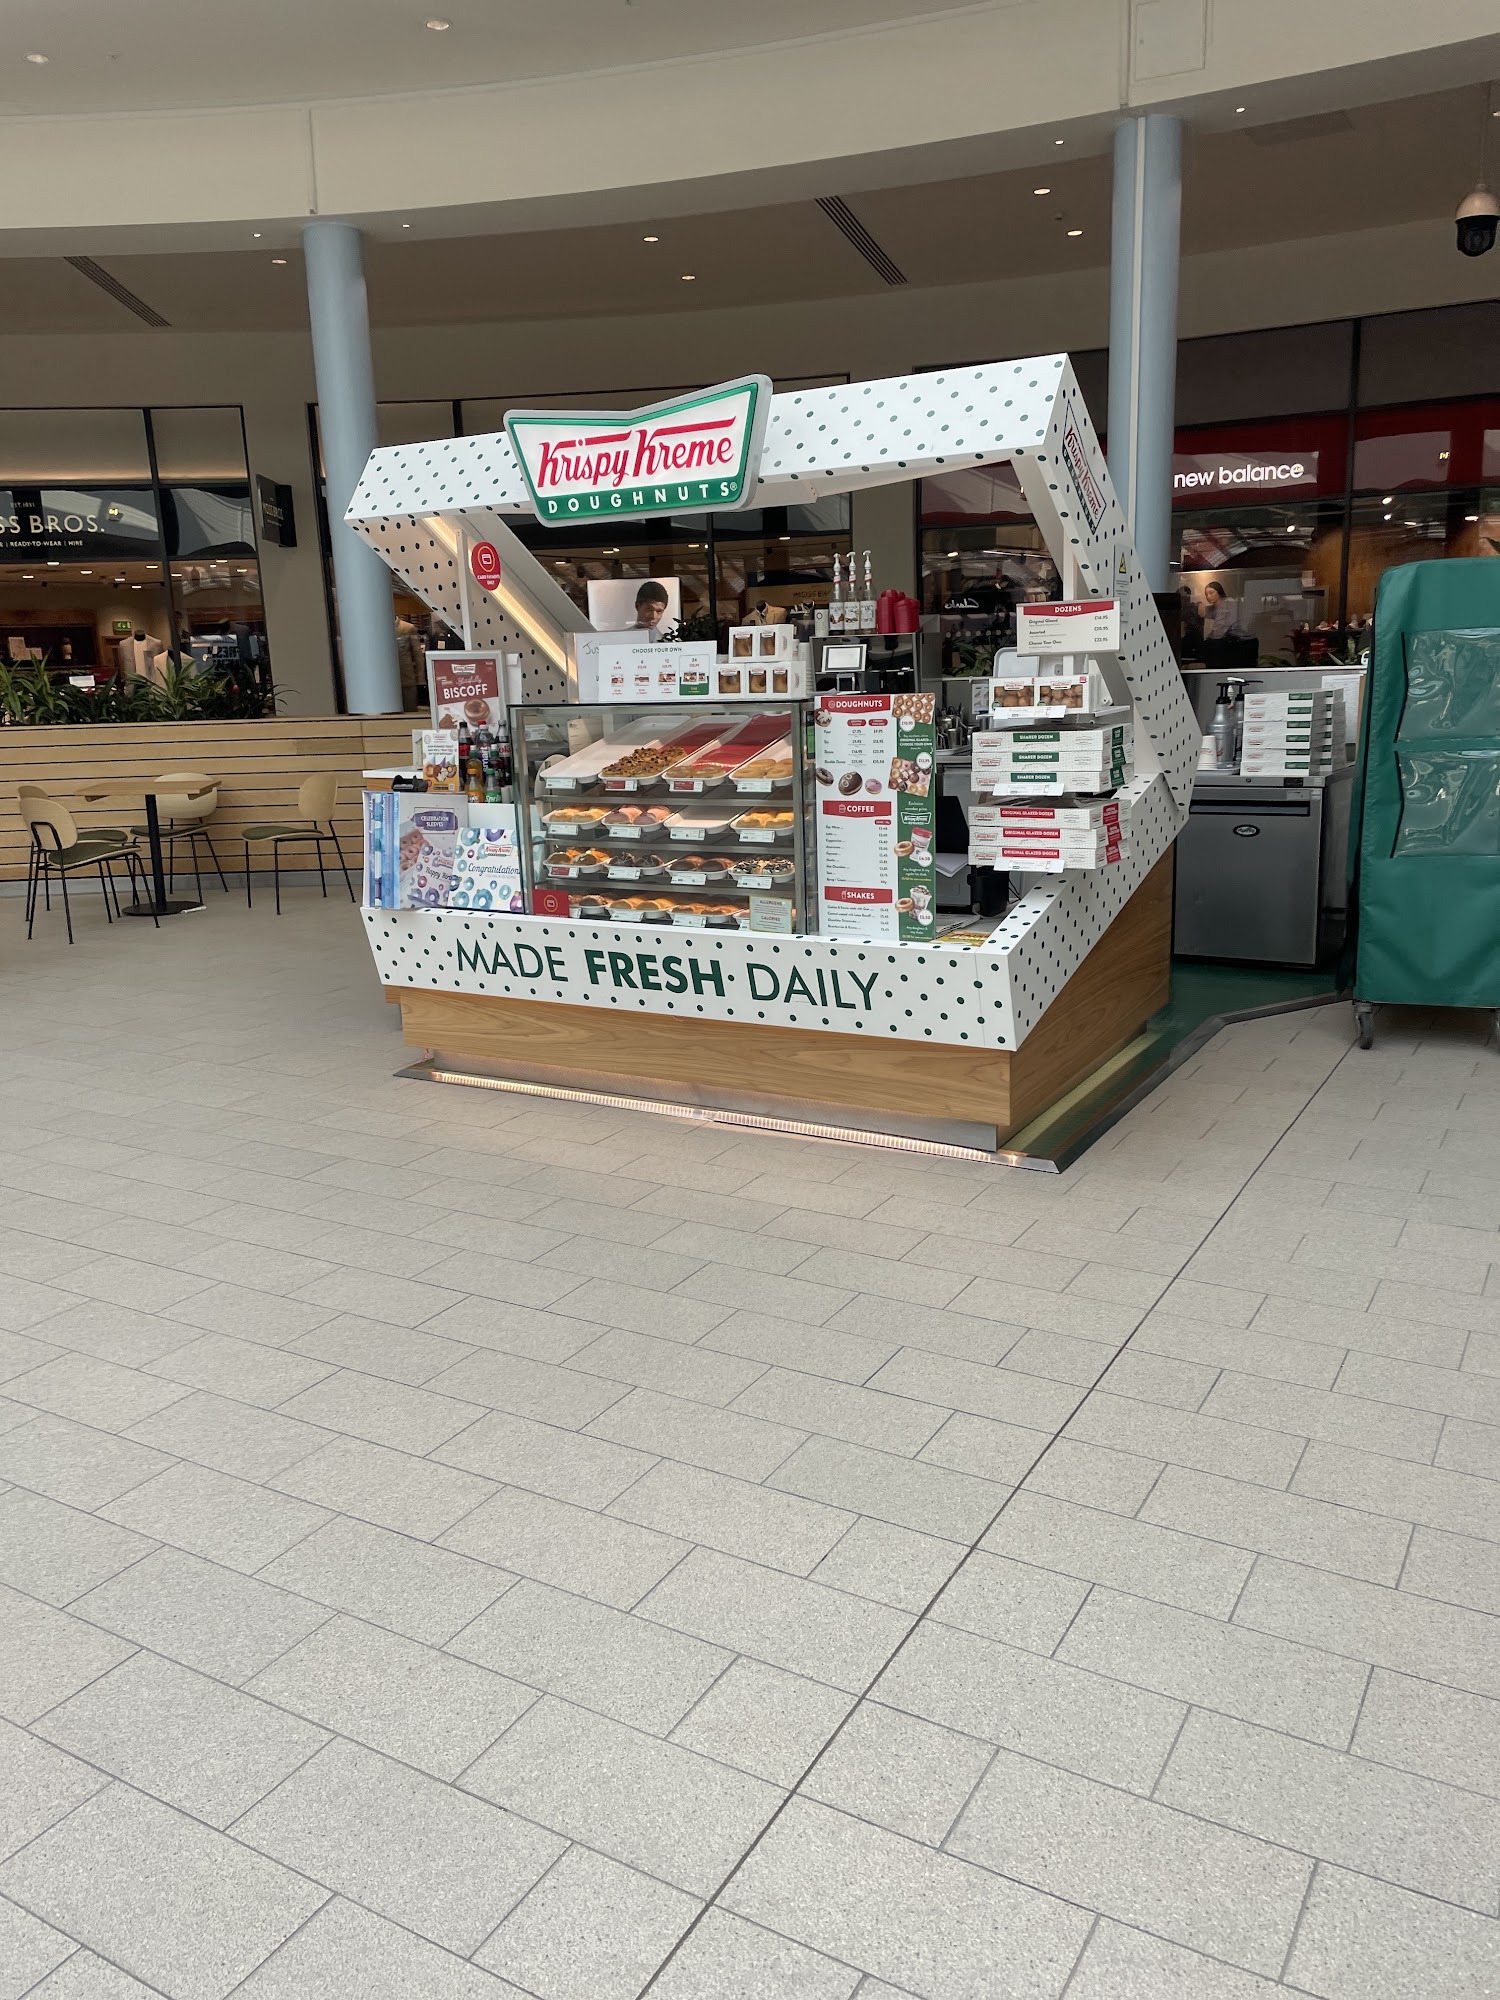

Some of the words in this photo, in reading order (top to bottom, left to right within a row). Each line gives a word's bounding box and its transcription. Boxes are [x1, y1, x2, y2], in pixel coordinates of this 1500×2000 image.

[537, 430, 632, 487] Krispy
[632, 416, 736, 478] Kreme
[1174, 470, 1215, 488] new
[1218, 463, 1305, 485] balance
[29, 514, 105, 533] BROS.
[443, 683, 488, 700] BISCOFF
[836, 700, 883, 708] DOUGHNUTS
[425, 866, 442, 879] Happy
[846, 891, 875, 900] SHAKES
[455, 937, 569, 983] MADE
[583, 949, 726, 998] FRESH
[745, 962, 880, 1011] DAILY
